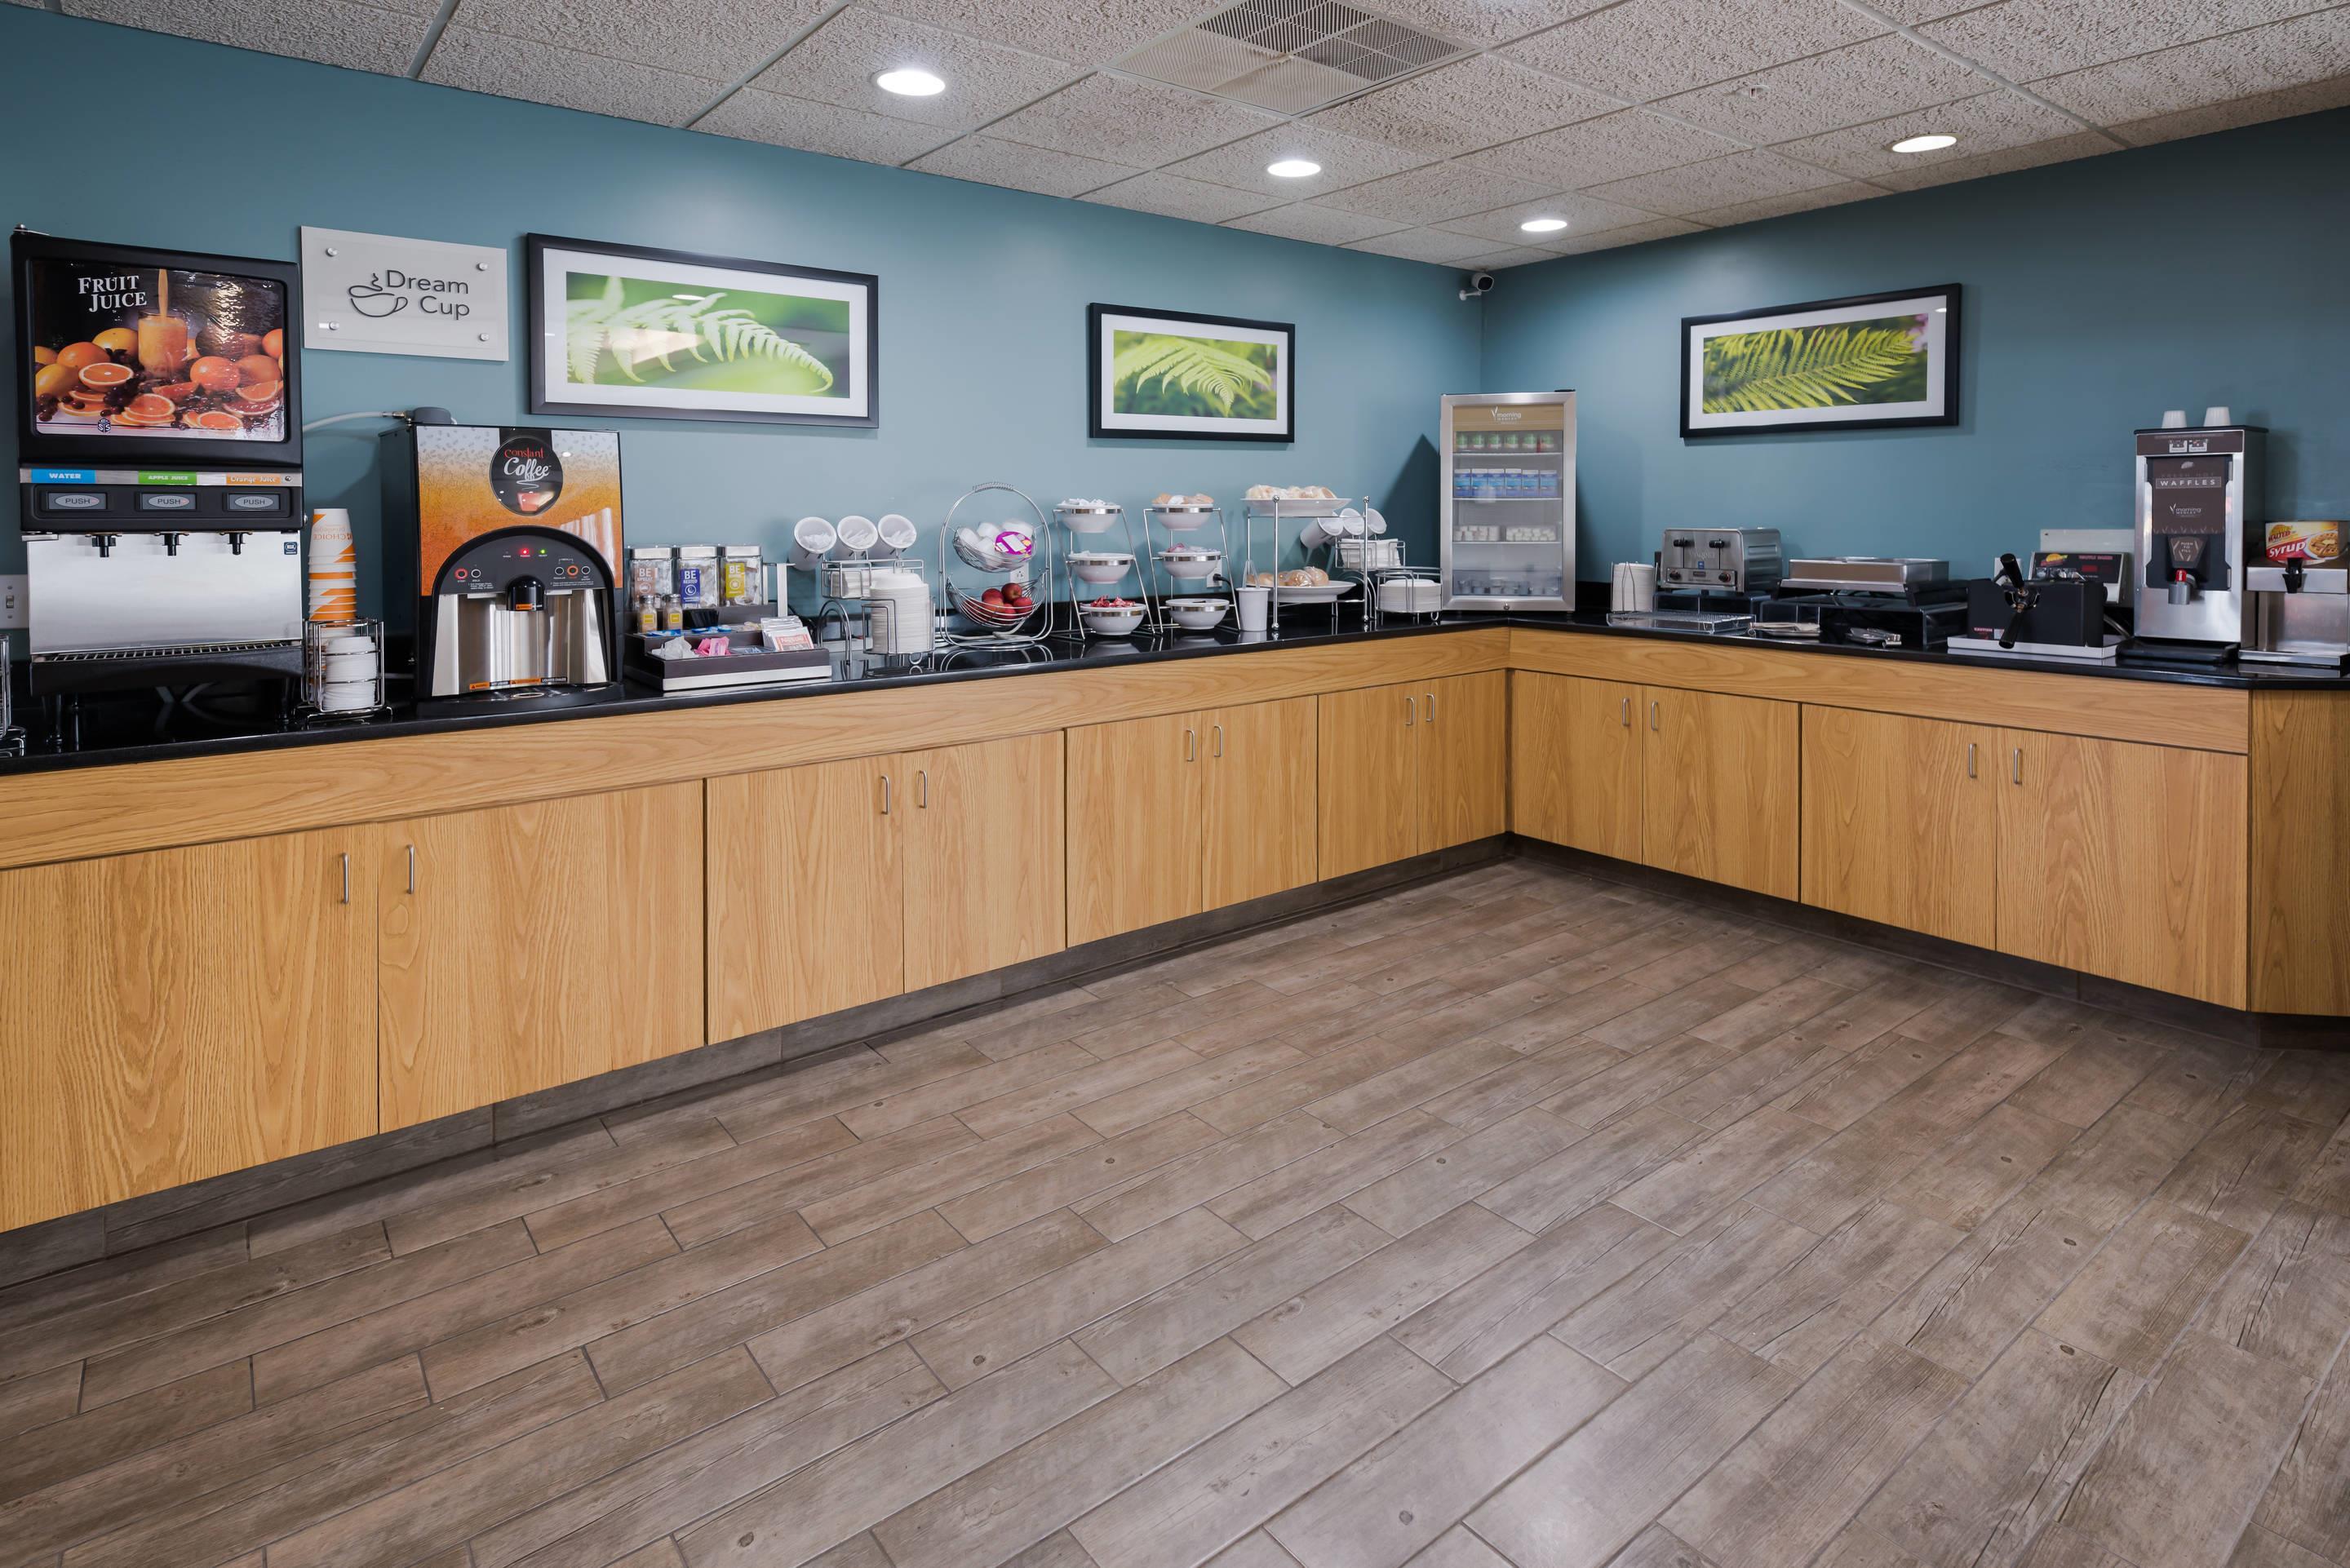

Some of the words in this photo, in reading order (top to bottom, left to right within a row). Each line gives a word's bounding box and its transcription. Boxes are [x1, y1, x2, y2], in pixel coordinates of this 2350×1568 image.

[78, 275, 140, 294] FRUIT
[385, 269, 469, 295] Dream
[88, 291, 147, 312] JUICE
[420, 295, 470, 321] Cup
[503, 457, 550, 481] Coffee
[2160, 479, 2216, 487] WAFFLES
[2269, 541, 2307, 558] Syrup
[639, 568, 652, 577] BE
[685, 570, 697, 579] BE
[729, 565, 741, 574] BE
